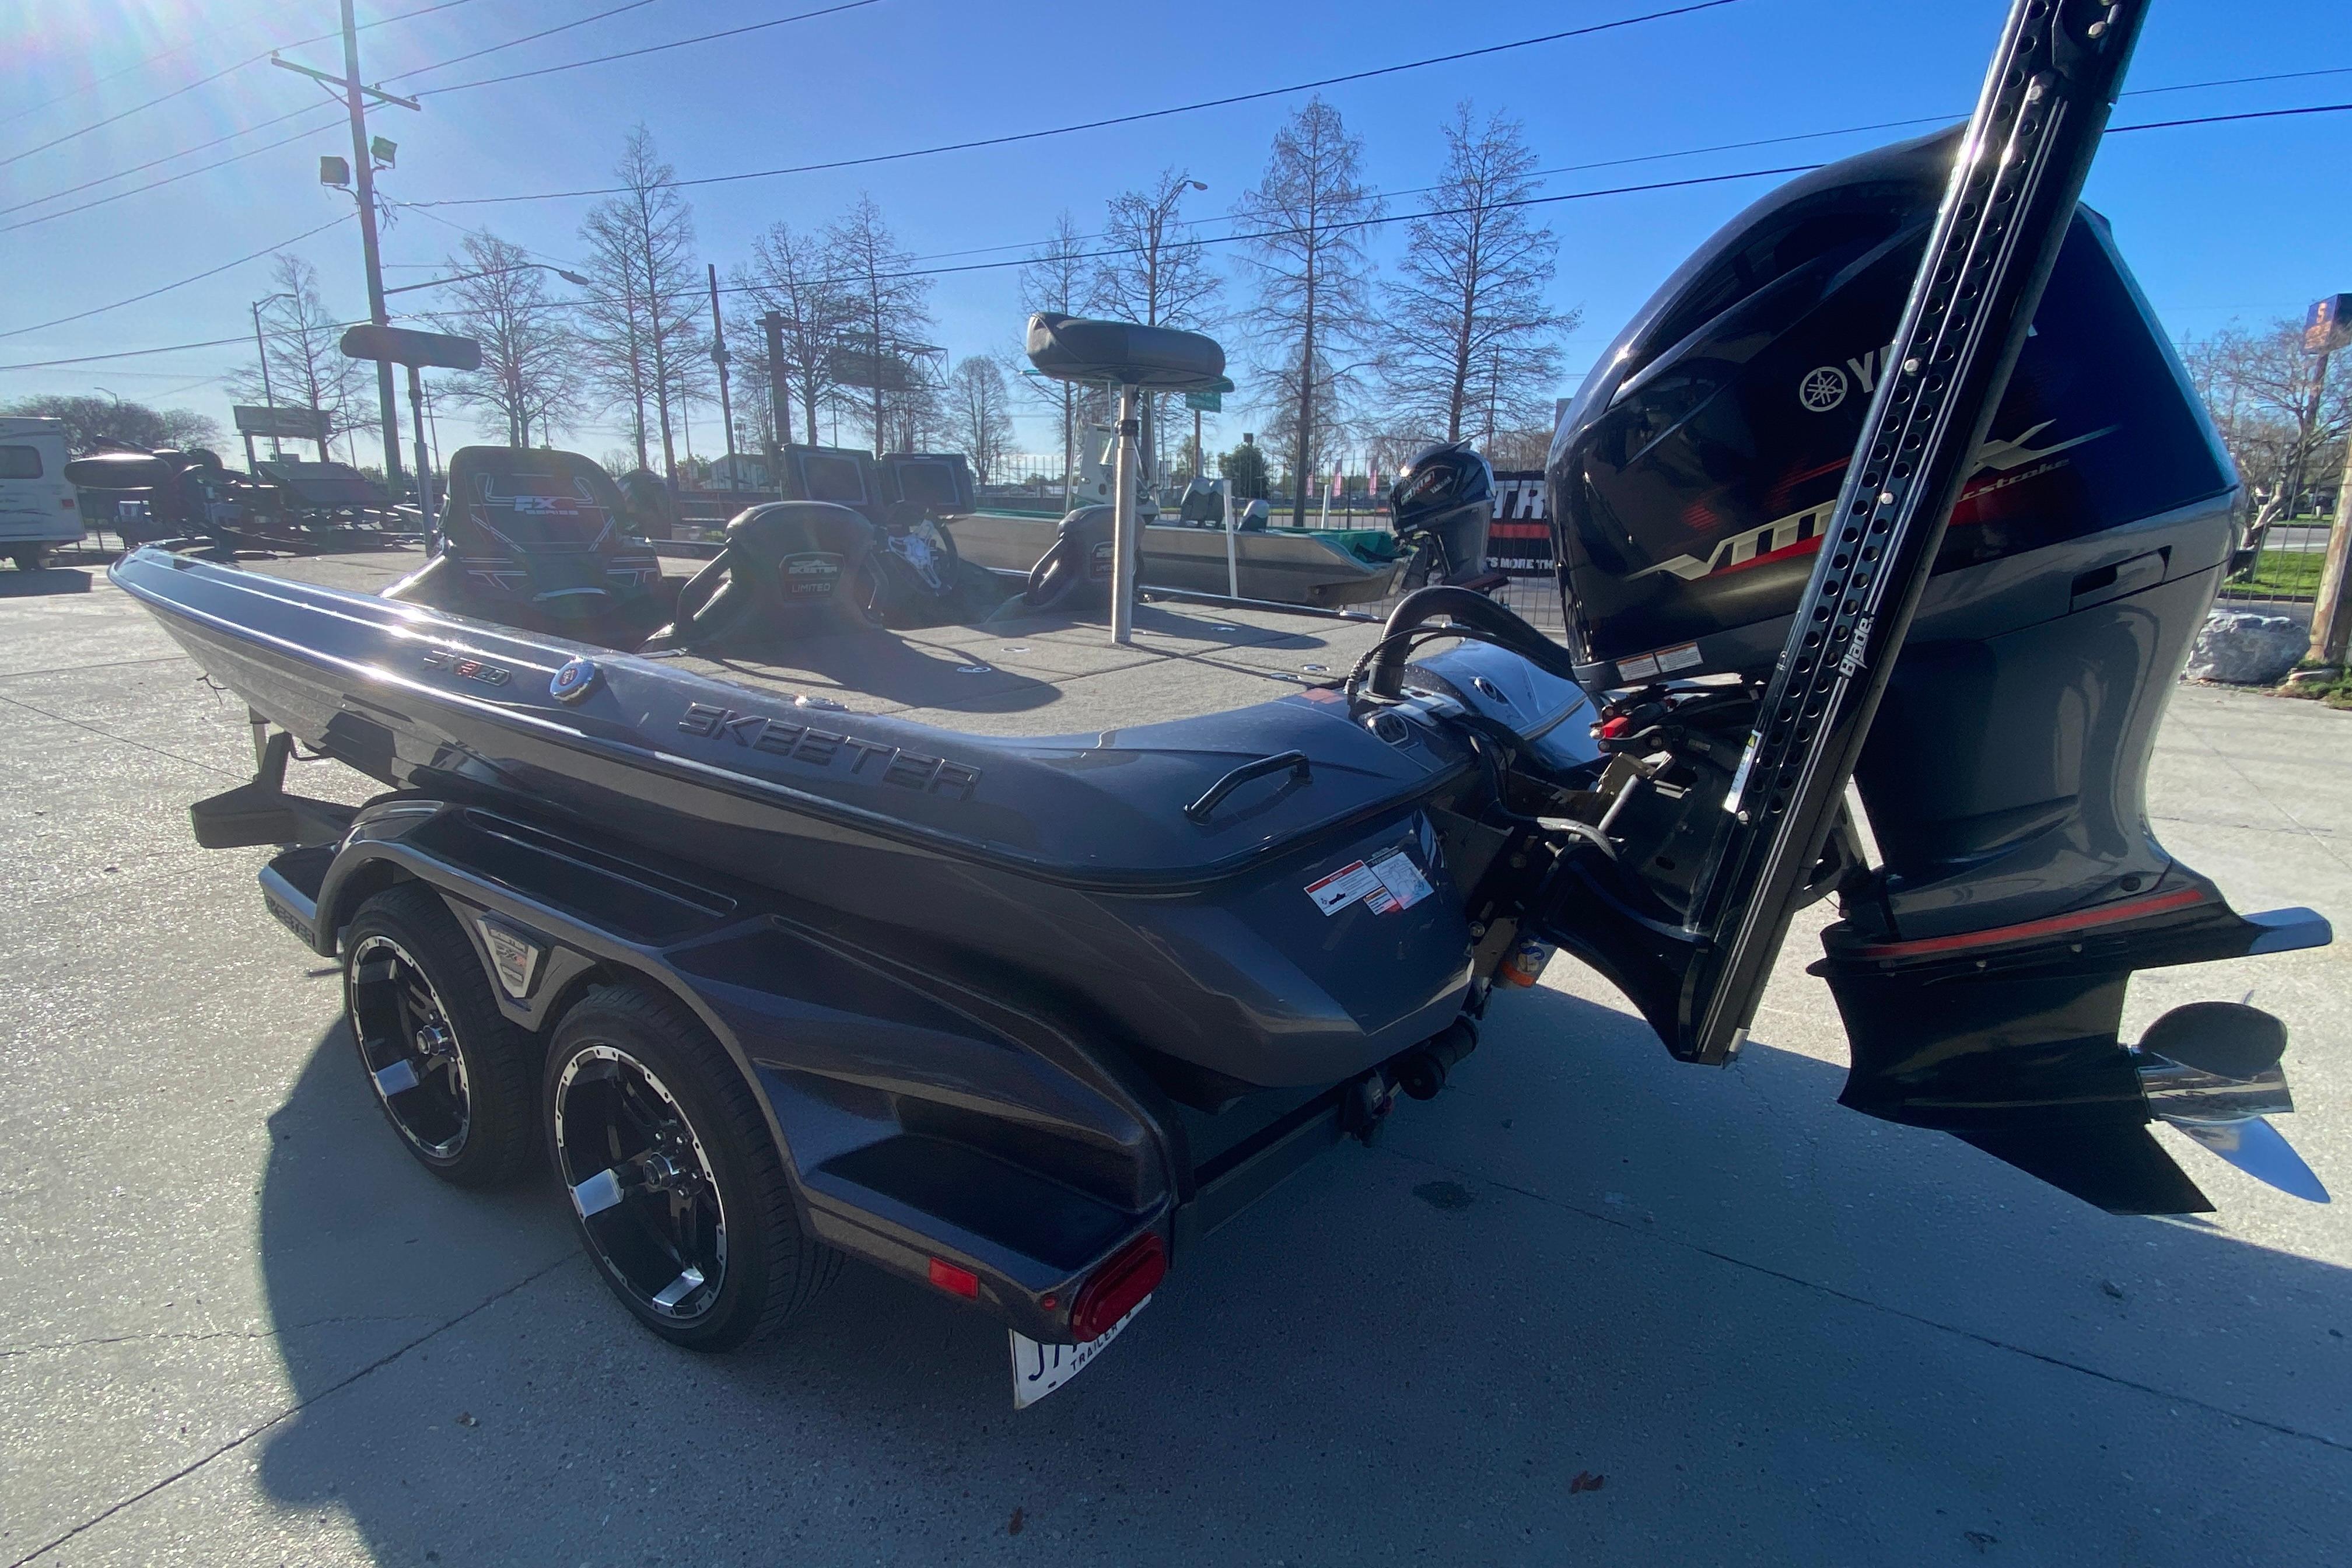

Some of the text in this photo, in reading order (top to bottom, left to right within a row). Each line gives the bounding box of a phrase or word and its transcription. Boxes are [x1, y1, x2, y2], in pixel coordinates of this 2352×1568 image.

[792, 583, 831, 593] LIMITED
[1500, 558, 1534, 569] MORE
[1536, 559, 1554, 570] TH
[1839, 617, 1871, 677] Blade
[677, 702, 982, 802] SKEETER
[1070, 1323, 1118, 1371] TRAILER
